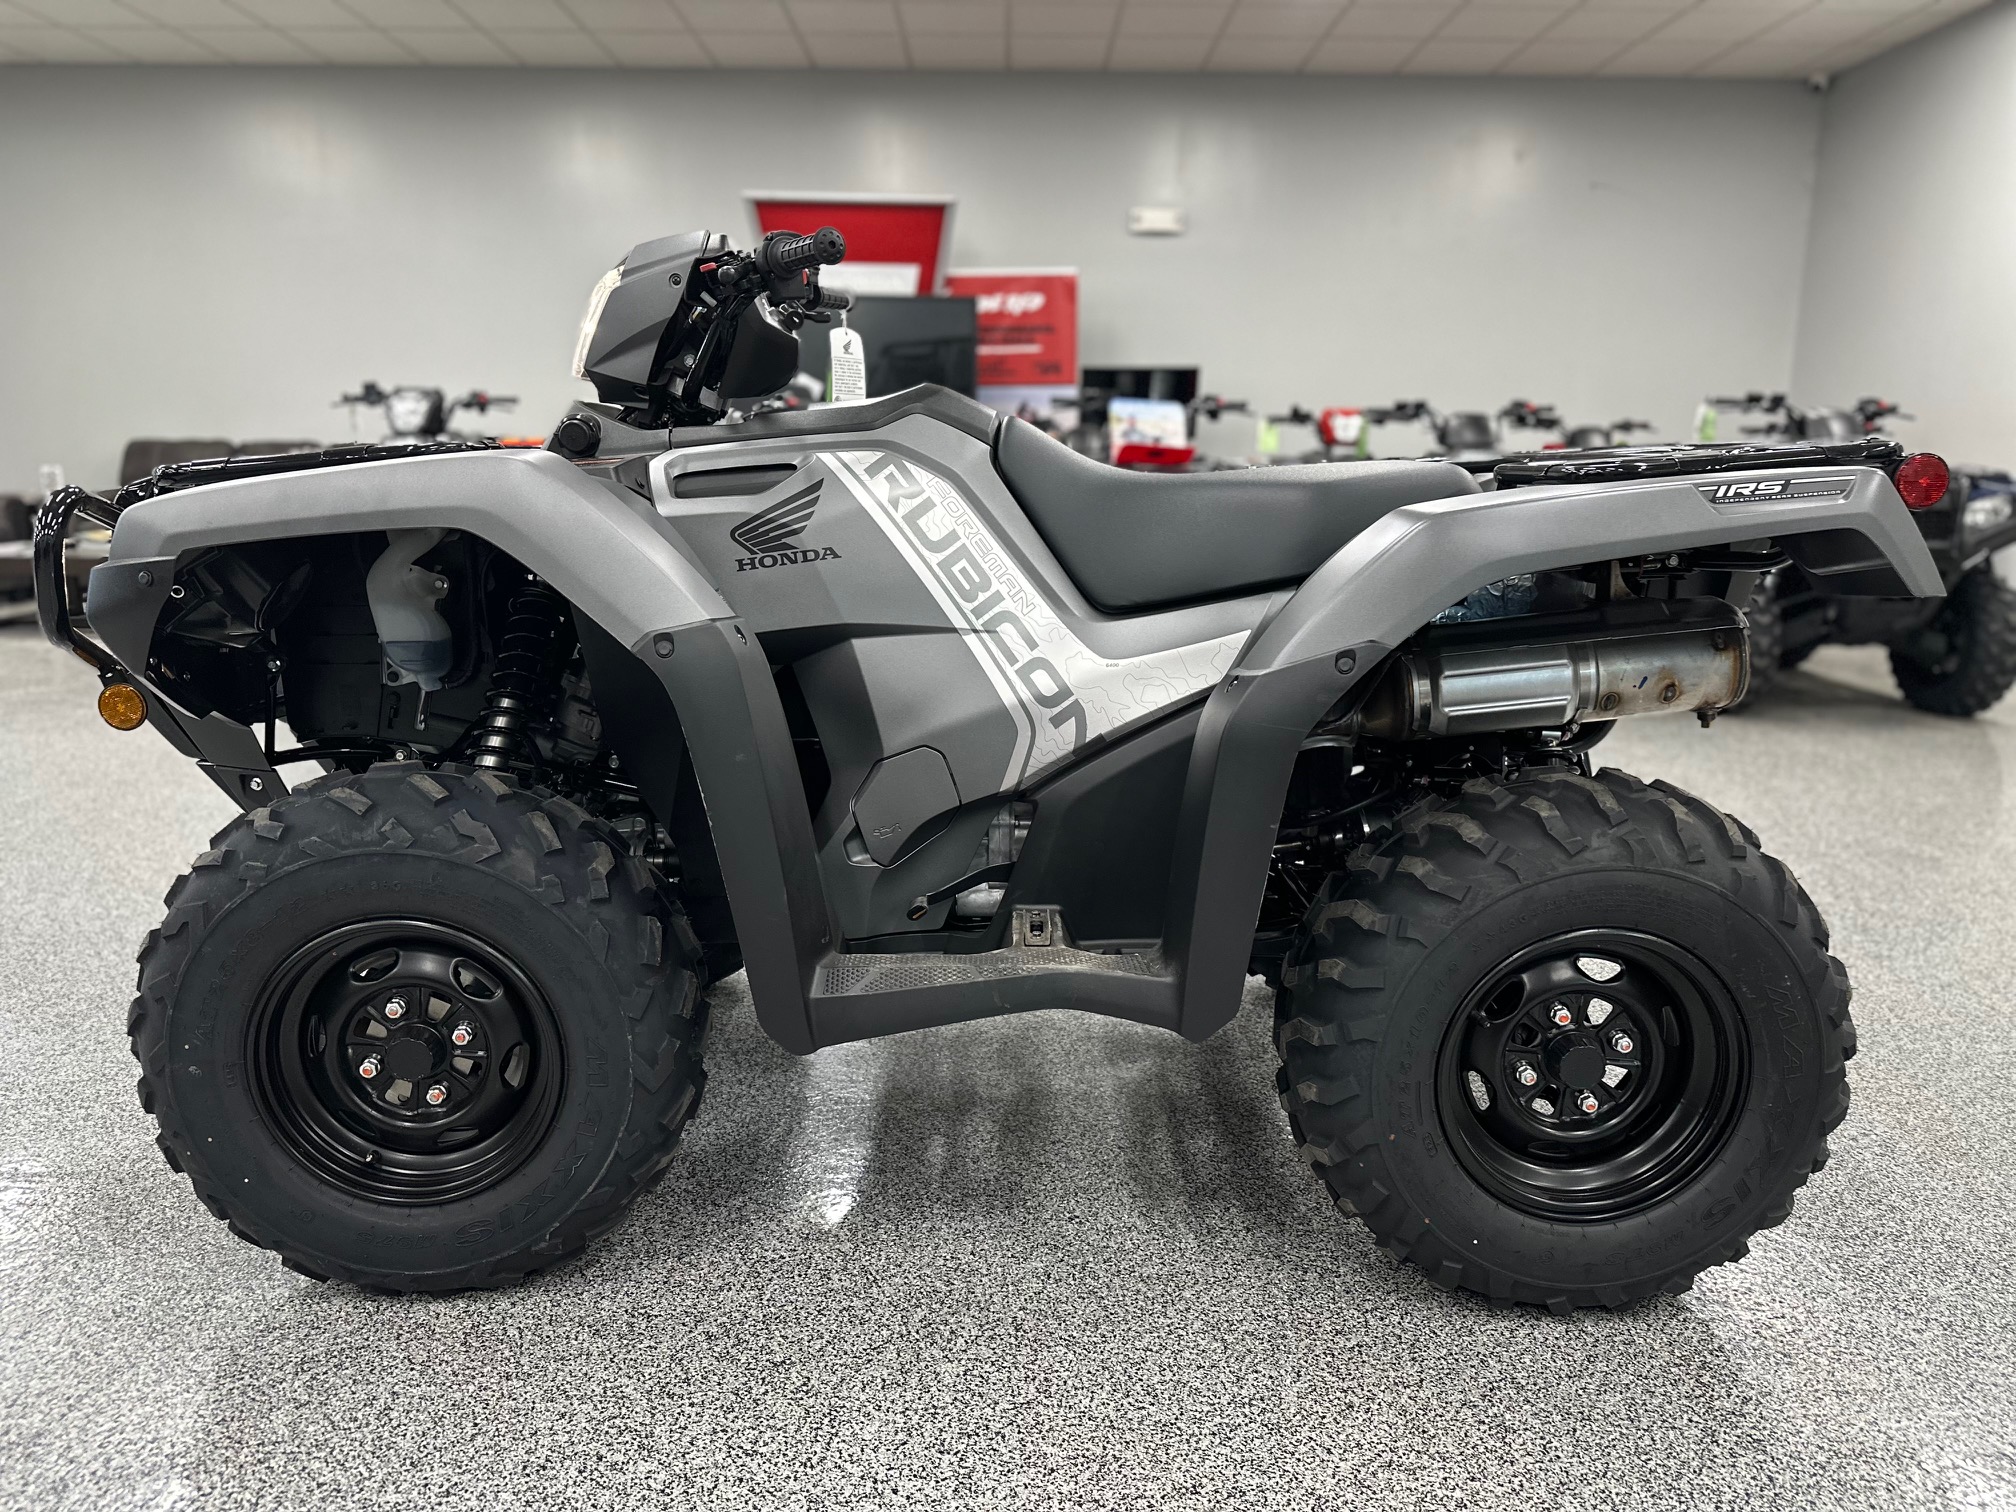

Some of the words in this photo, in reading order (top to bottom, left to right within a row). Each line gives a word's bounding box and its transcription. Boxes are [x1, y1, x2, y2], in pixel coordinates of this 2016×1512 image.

[735, 547, 842, 572] HONDA
[926, 476, 1036, 616] FOREMAN
[1715, 481, 1786, 498] IRS
[1716, 495, 1770, 503] INDEPENDENT
[1793, 490, 1841, 498] SUSPENSION
[863, 453, 1087, 756] RUBICON
[455, 1034, 608, 1247] MAXXIS
[1701, 985, 1804, 1230] MAXXIS
